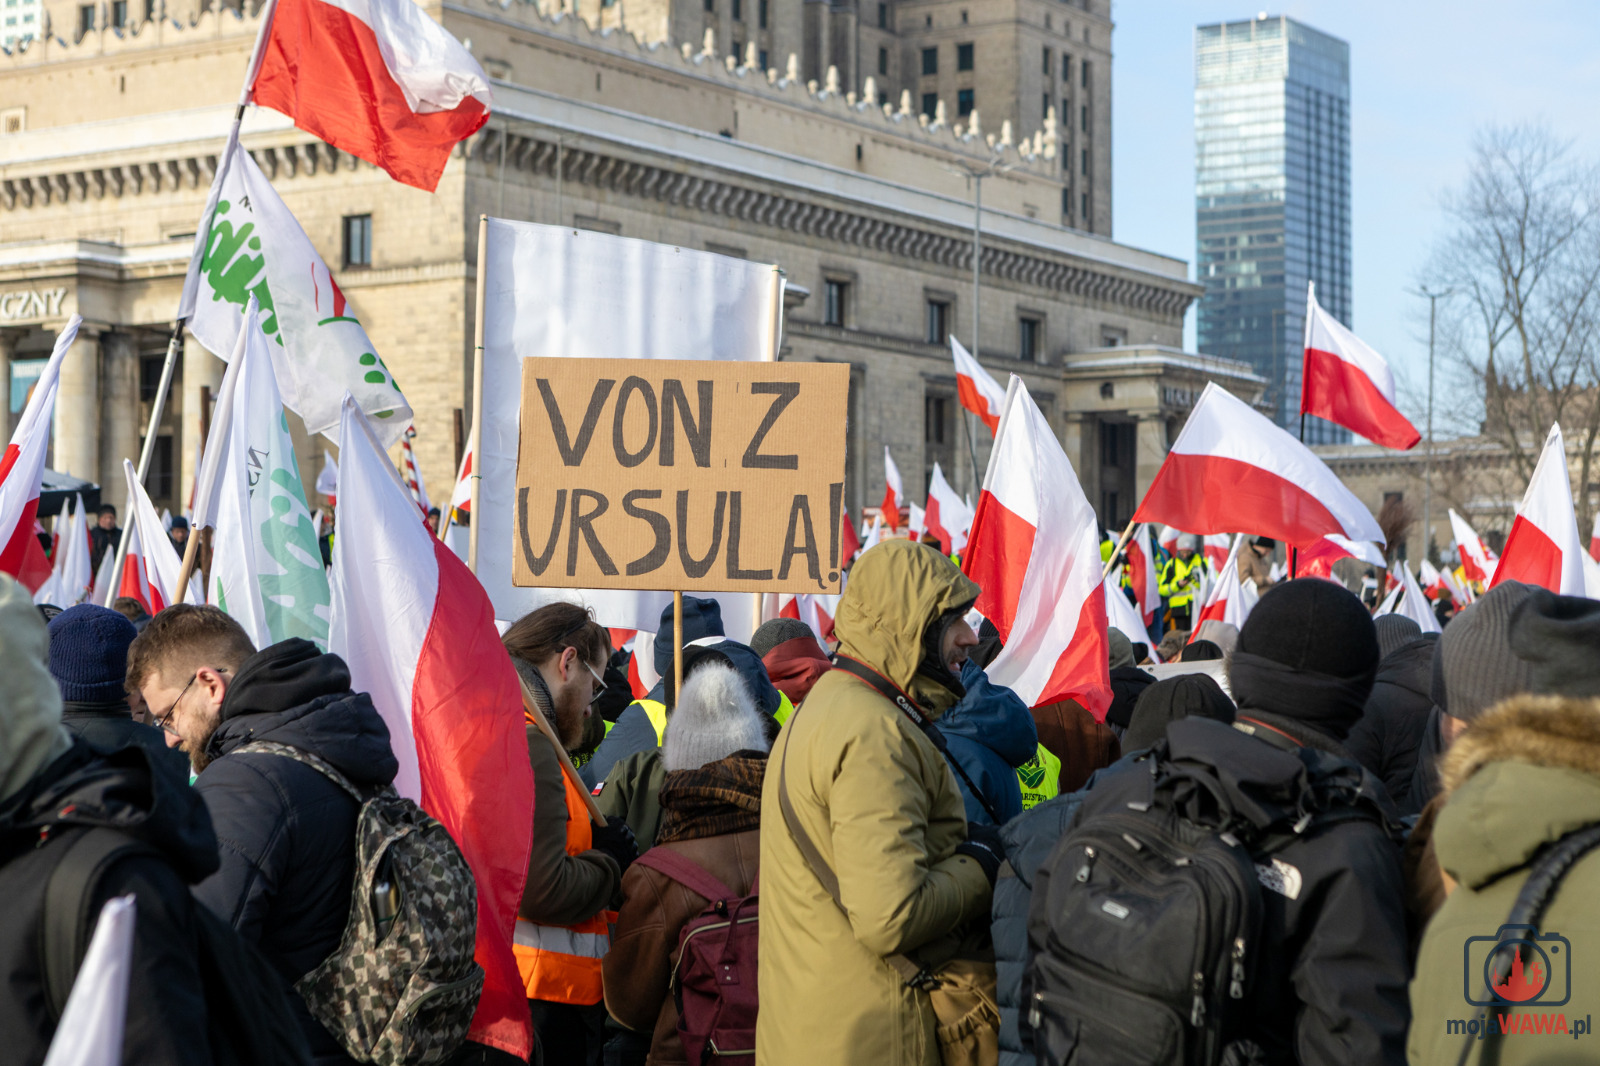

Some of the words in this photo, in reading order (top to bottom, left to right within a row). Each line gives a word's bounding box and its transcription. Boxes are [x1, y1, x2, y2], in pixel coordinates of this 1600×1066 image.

[0, 287, 67, 319] CZNY
[535, 375, 713, 468] VON
[742, 381, 800, 470] Z
[518, 482, 844, 589] URSULA!
[896, 695, 922, 723] Canon
